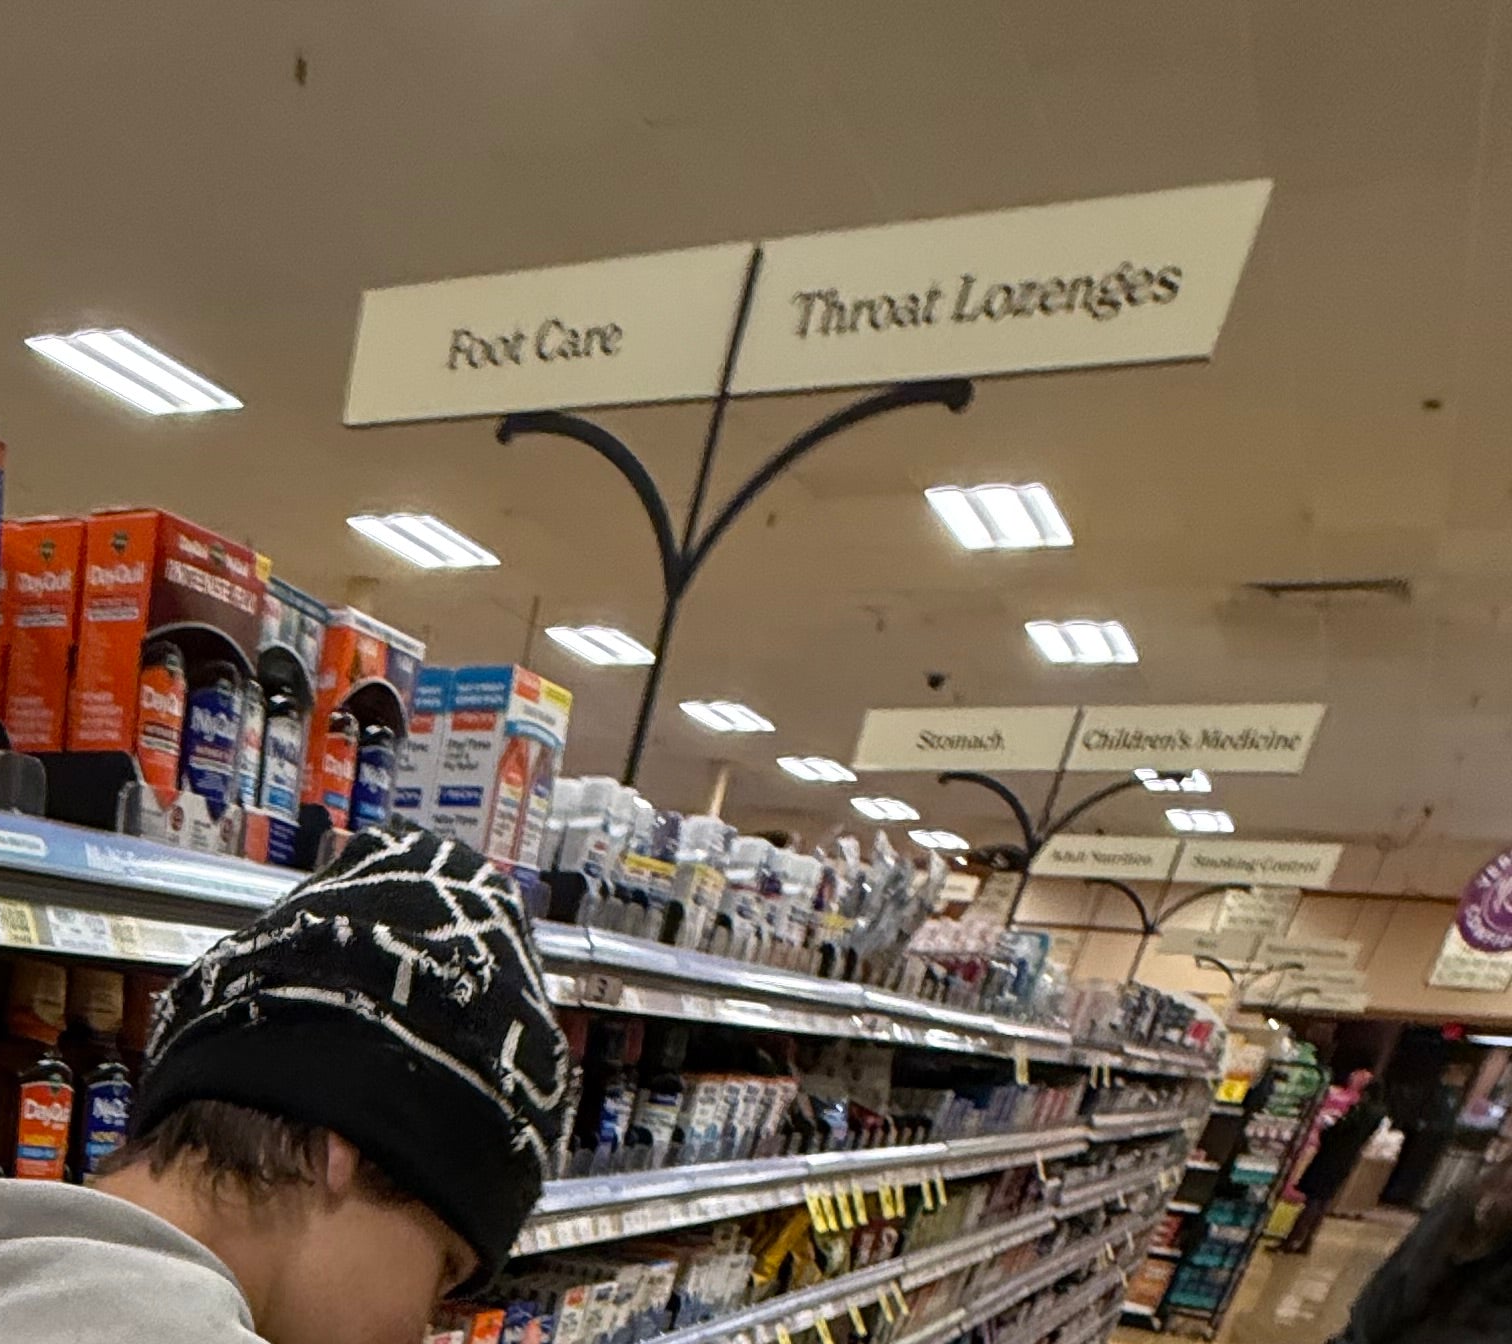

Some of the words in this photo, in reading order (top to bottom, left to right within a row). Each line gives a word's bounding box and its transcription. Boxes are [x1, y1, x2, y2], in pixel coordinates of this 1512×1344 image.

[791, 284, 942, 339] Throat
[952, 263, 1183, 323] Lozenges
[447, 328, 524, 370] Foot
[535, 319, 623, 363] Care
[916, 731, 1005, 751] Stomach
[1197, 729, 1302, 752] Medicine
